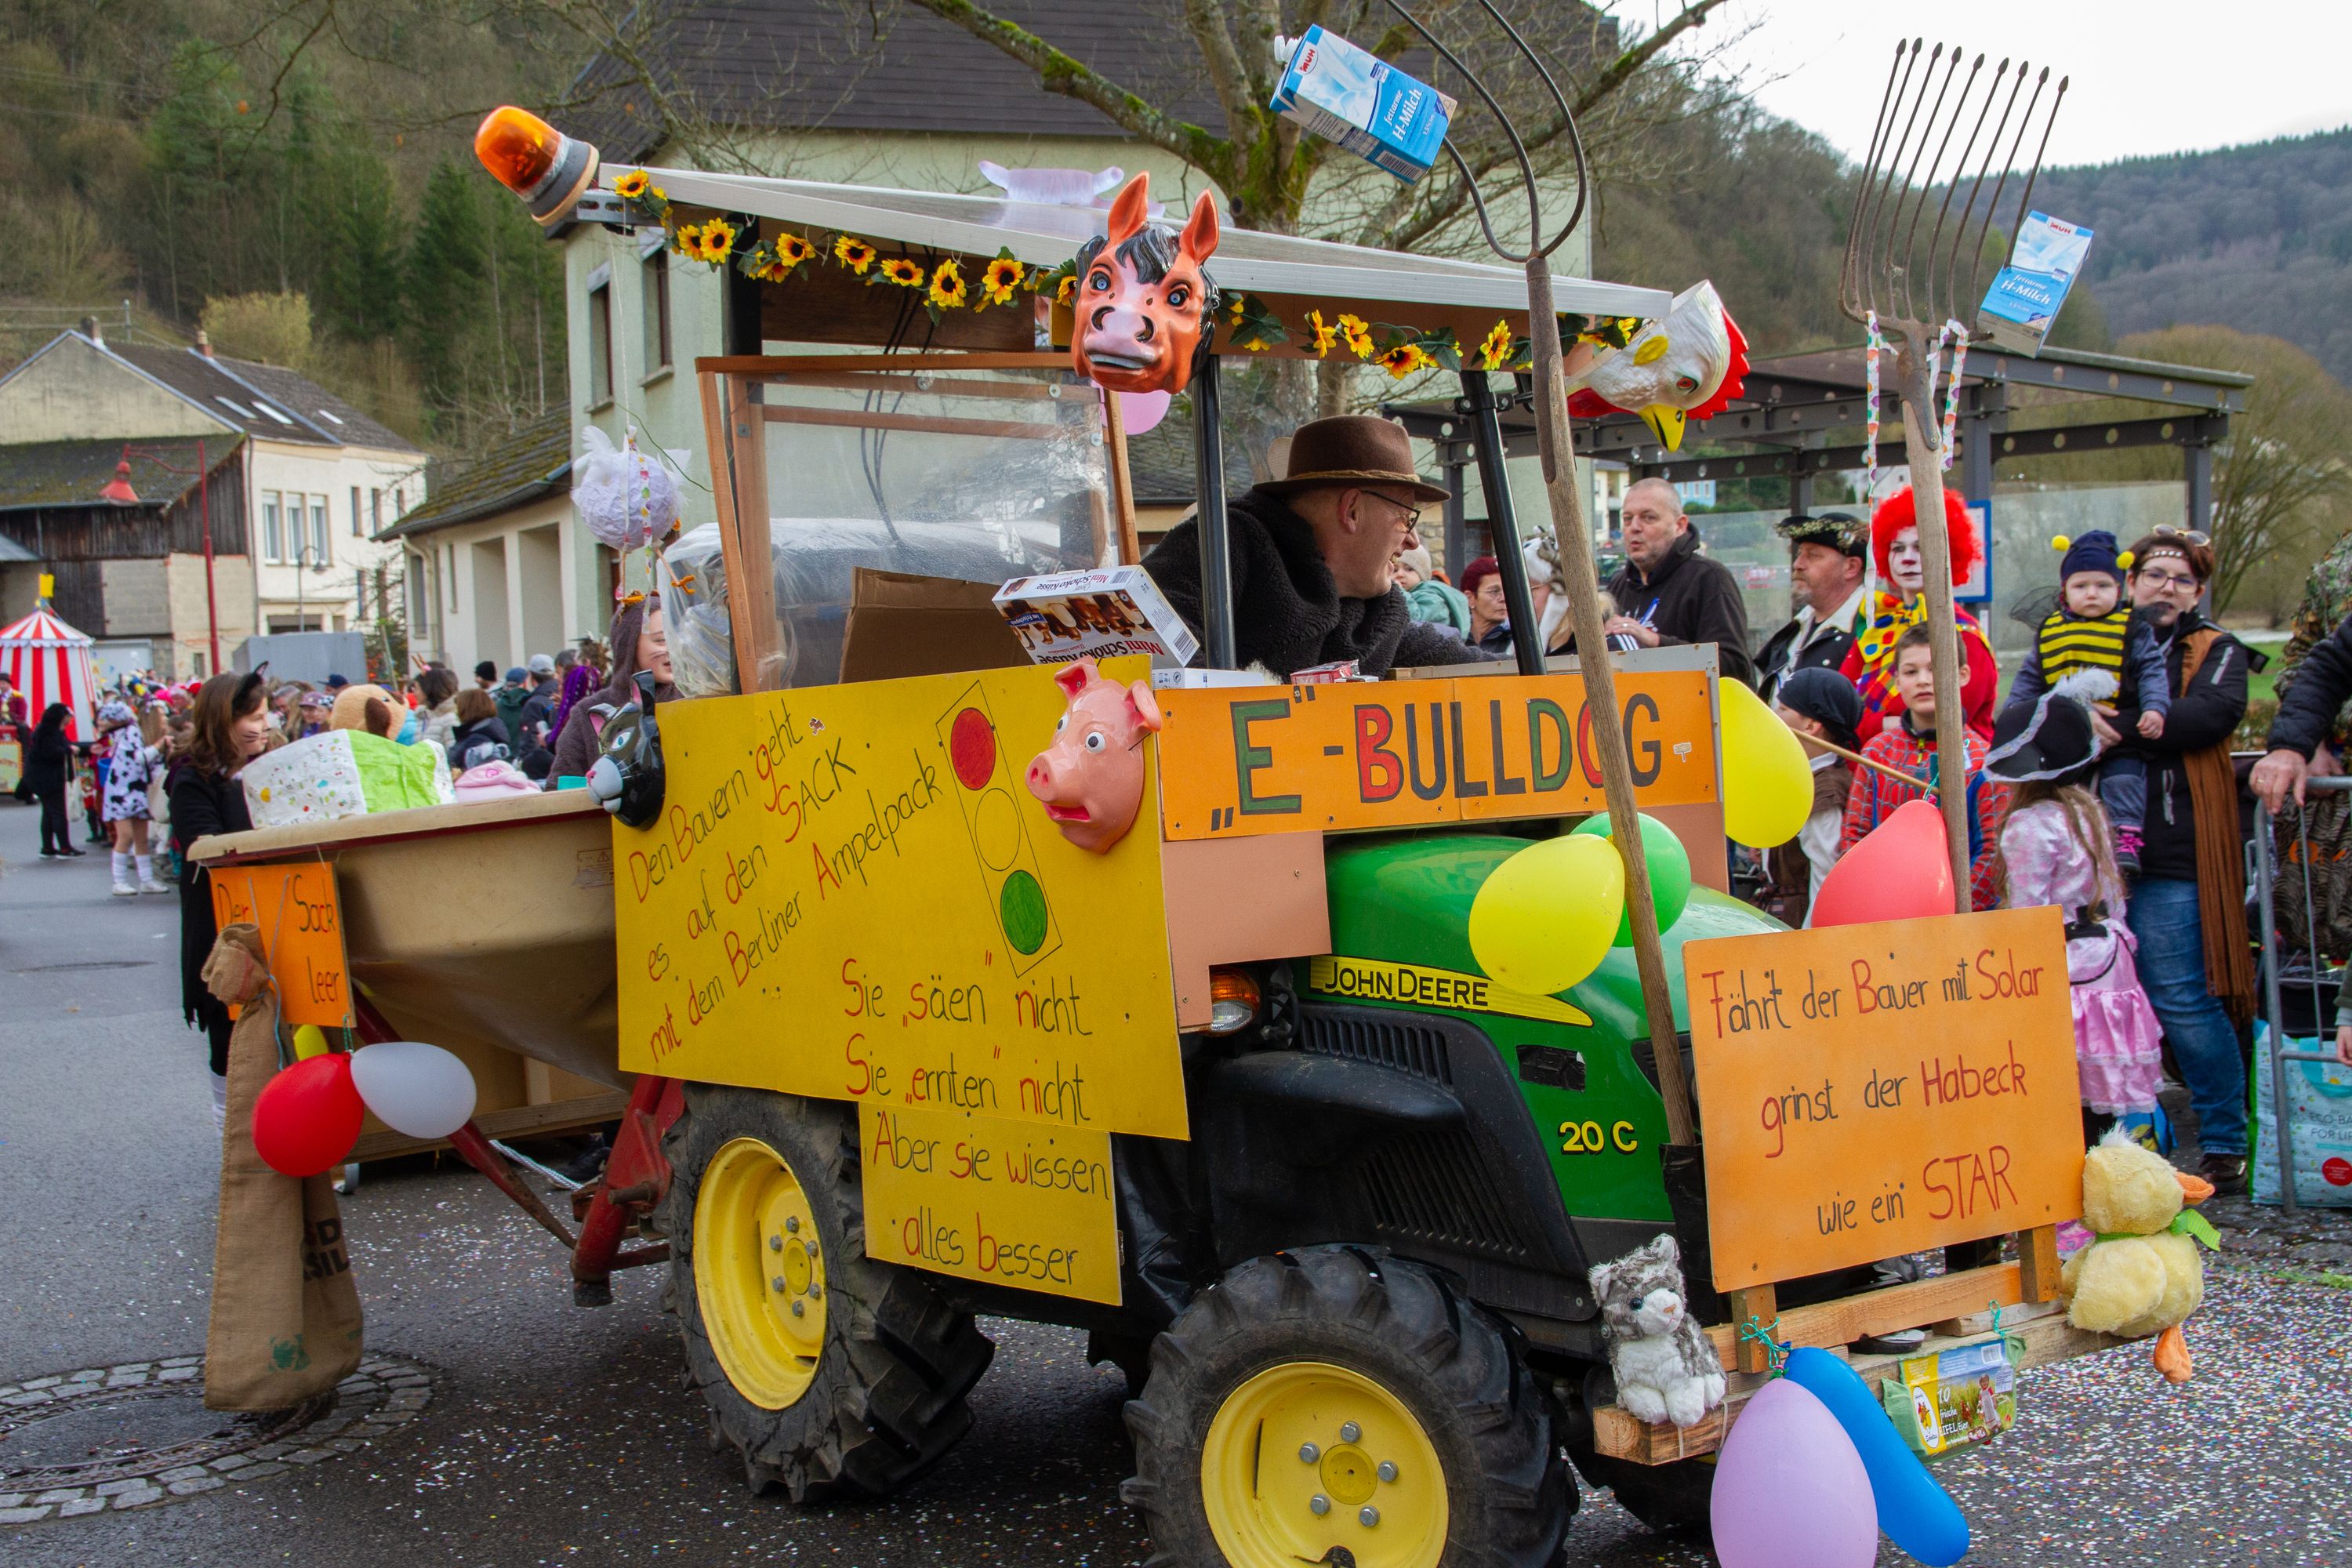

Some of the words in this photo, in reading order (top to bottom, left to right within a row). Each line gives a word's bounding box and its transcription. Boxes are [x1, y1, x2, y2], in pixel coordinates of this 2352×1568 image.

[1300, 49, 1316, 73] MUH
[1384, 89, 1403, 125] fettarme
[1392, 89, 1423, 141] H-Milch
[2001, 280, 2051, 305] H-Milch
[2014, 274, 2046, 291] fettarme
[630, 844, 672, 903] Den
[670, 769, 749, 862] Bauern
[756, 699, 803, 812] geht
[648, 941, 670, 982] es
[687, 868, 717, 942] auf
[724, 845, 768, 906] den
[776, 737, 856, 844] SACK
[217, 884, 249, 927] Der
[292, 873, 336, 933] Sack
[649, 1002, 682, 1065] mit
[688, 974, 724, 1027] dem
[724, 889, 803, 989] Berliner
[811, 748, 943, 904] Ampelpack
[843, 958, 886, 1019] Sie
[1015, 976, 1094, 1036] nicht
[1325, 961, 1392, 995] JOHN
[1398, 969, 1489, 1007] DEERE
[1701, 969, 1791, 1039] Fährt
[1802, 970, 1842, 1019] der
[1851, 959, 1928, 1014] Bauer
[1942, 958, 1973, 1002] mit
[1976, 948, 2044, 1000] Solar
[847, 1033, 891, 1098] Sie
[1020, 1060, 1091, 1124] nicht
[1760, 1079, 1838, 1158] grinst
[1864, 1069, 1908, 1109] der
[1920, 1040, 2027, 1107] Habeck
[873, 1110, 942, 1174] Aber
[949, 1134, 992, 1181] sie
[1007, 1143, 1110, 1201] wissen
[1558, 1120, 1606, 1156] 20
[1611, 1120, 1639, 1155] C
[1817, 1191, 1857, 1236] wie
[1871, 1182, 1904, 1222] ein
[1922, 1145, 2018, 1220] STAR
[903, 1206, 964, 1266] alles
[977, 1212, 1080, 1287] besser
[1937, 1387, 1951, 1404] 10
